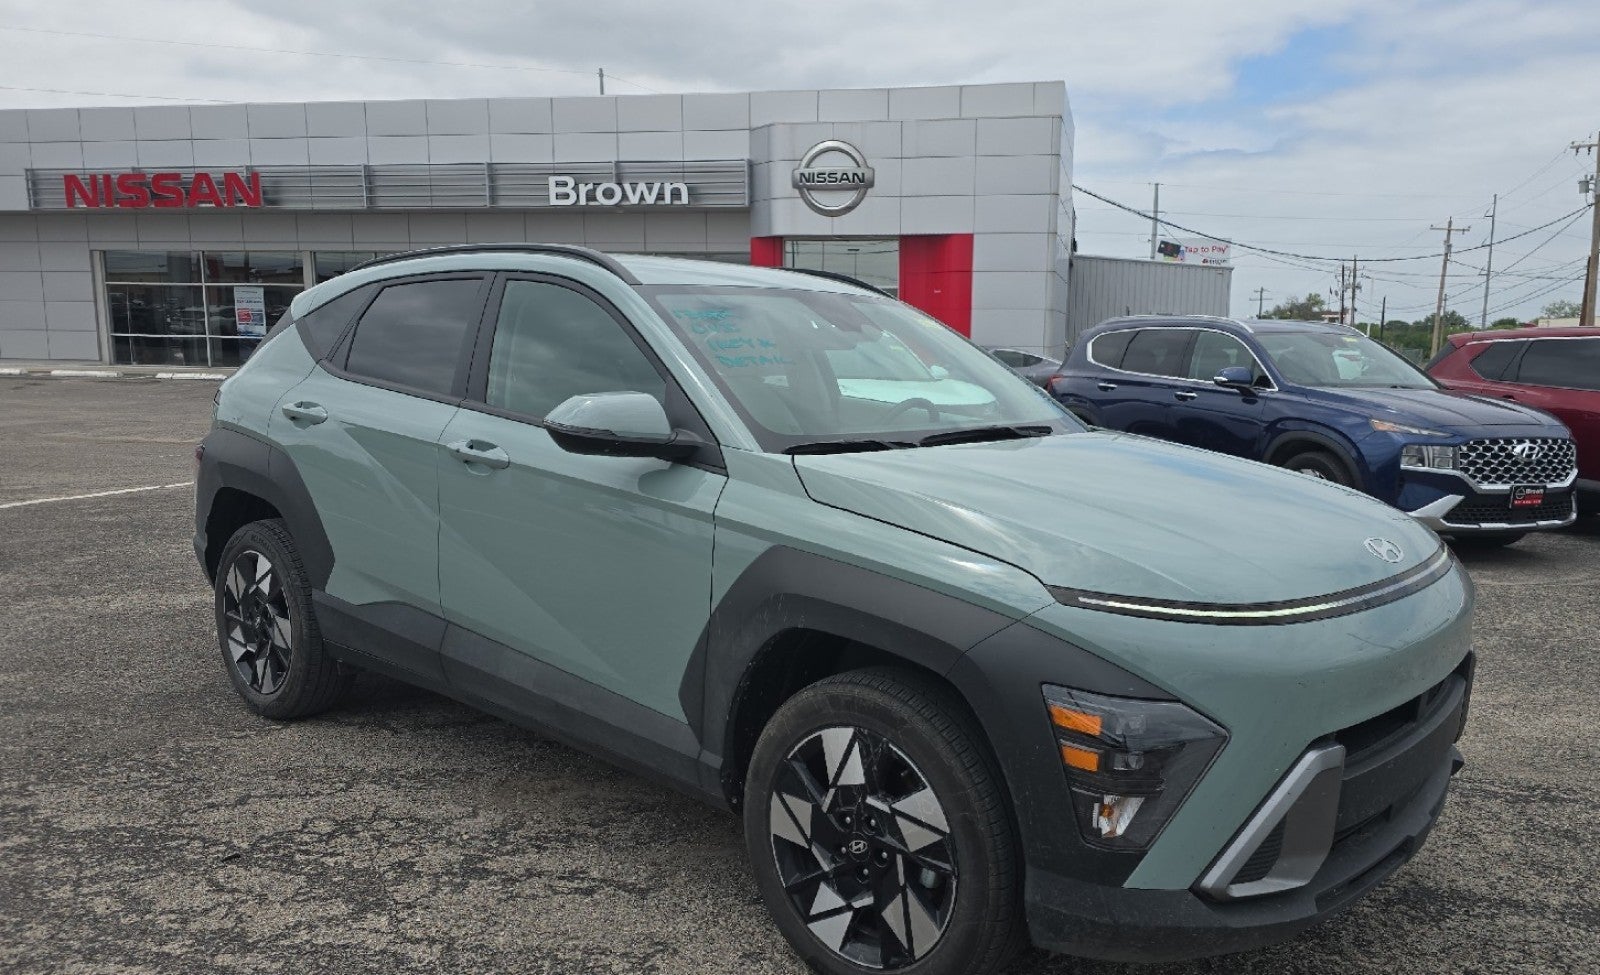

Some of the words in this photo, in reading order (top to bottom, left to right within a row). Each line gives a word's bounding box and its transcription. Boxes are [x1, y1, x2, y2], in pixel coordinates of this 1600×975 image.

[799, 171, 866, 185] NISSAN
[63, 172, 262, 208] NISSAN
[548, 175, 690, 207] Brown
[1185, 246, 1199, 254] Tap
[1211, 245, 1227, 254] Pay
